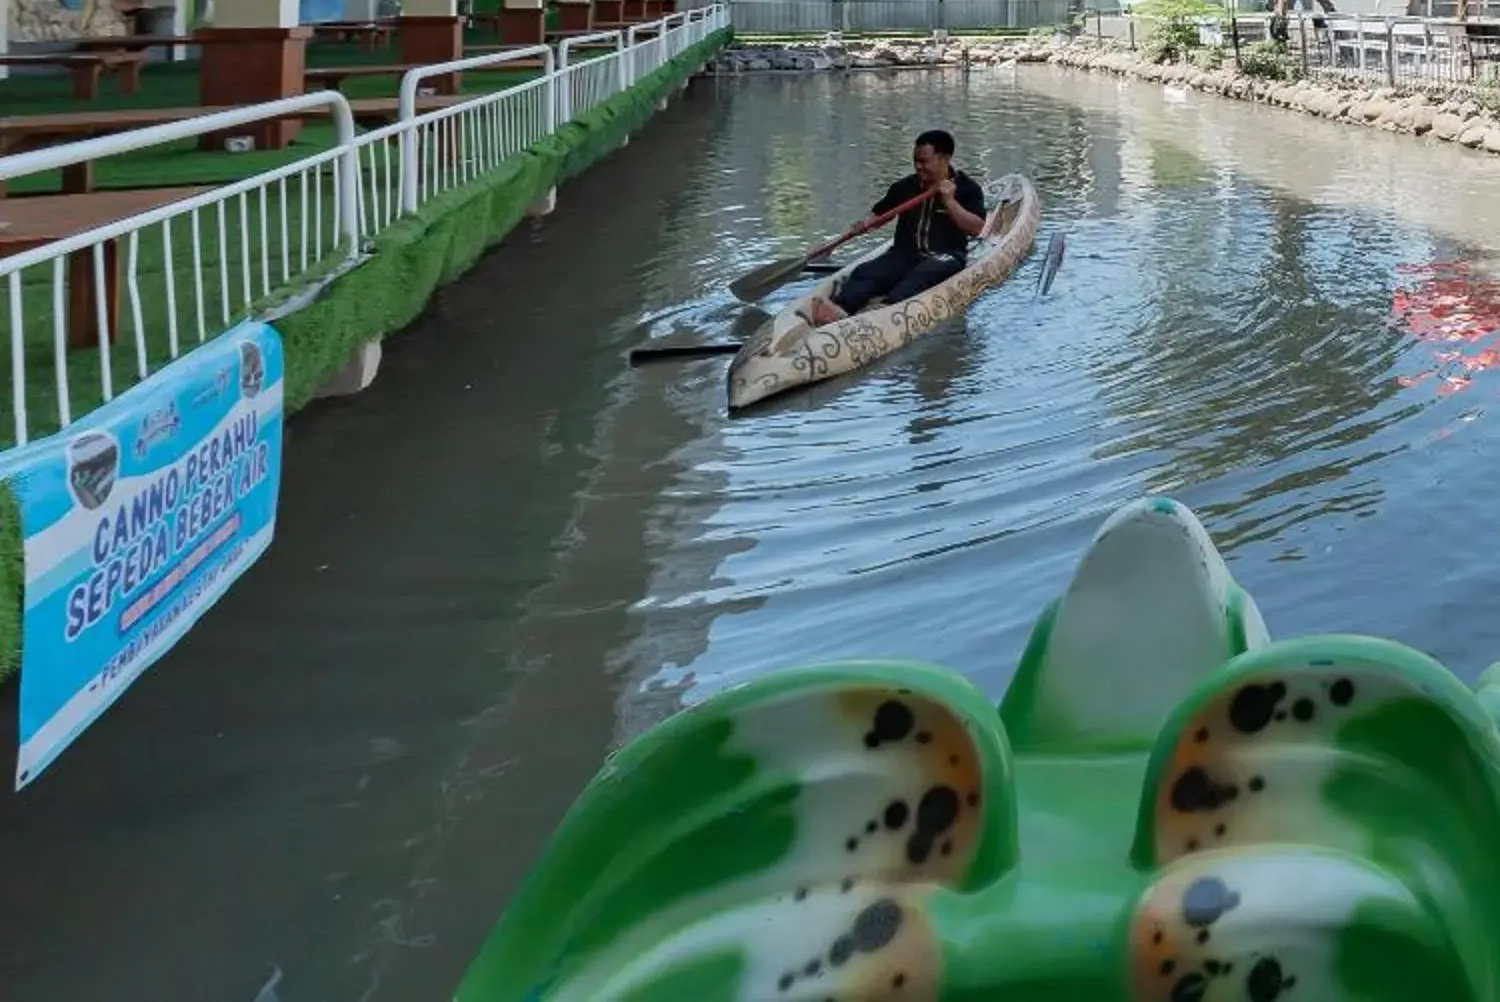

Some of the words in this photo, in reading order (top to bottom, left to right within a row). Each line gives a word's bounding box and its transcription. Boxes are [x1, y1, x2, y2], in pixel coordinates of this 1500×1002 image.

[67, 526, 167, 638] SEPEDA
[176, 473, 234, 551] BEBEK
[239, 443, 266, 496] AIR
[94, 468, 178, 564] CANNO
[186, 409, 256, 492] PERAHU
